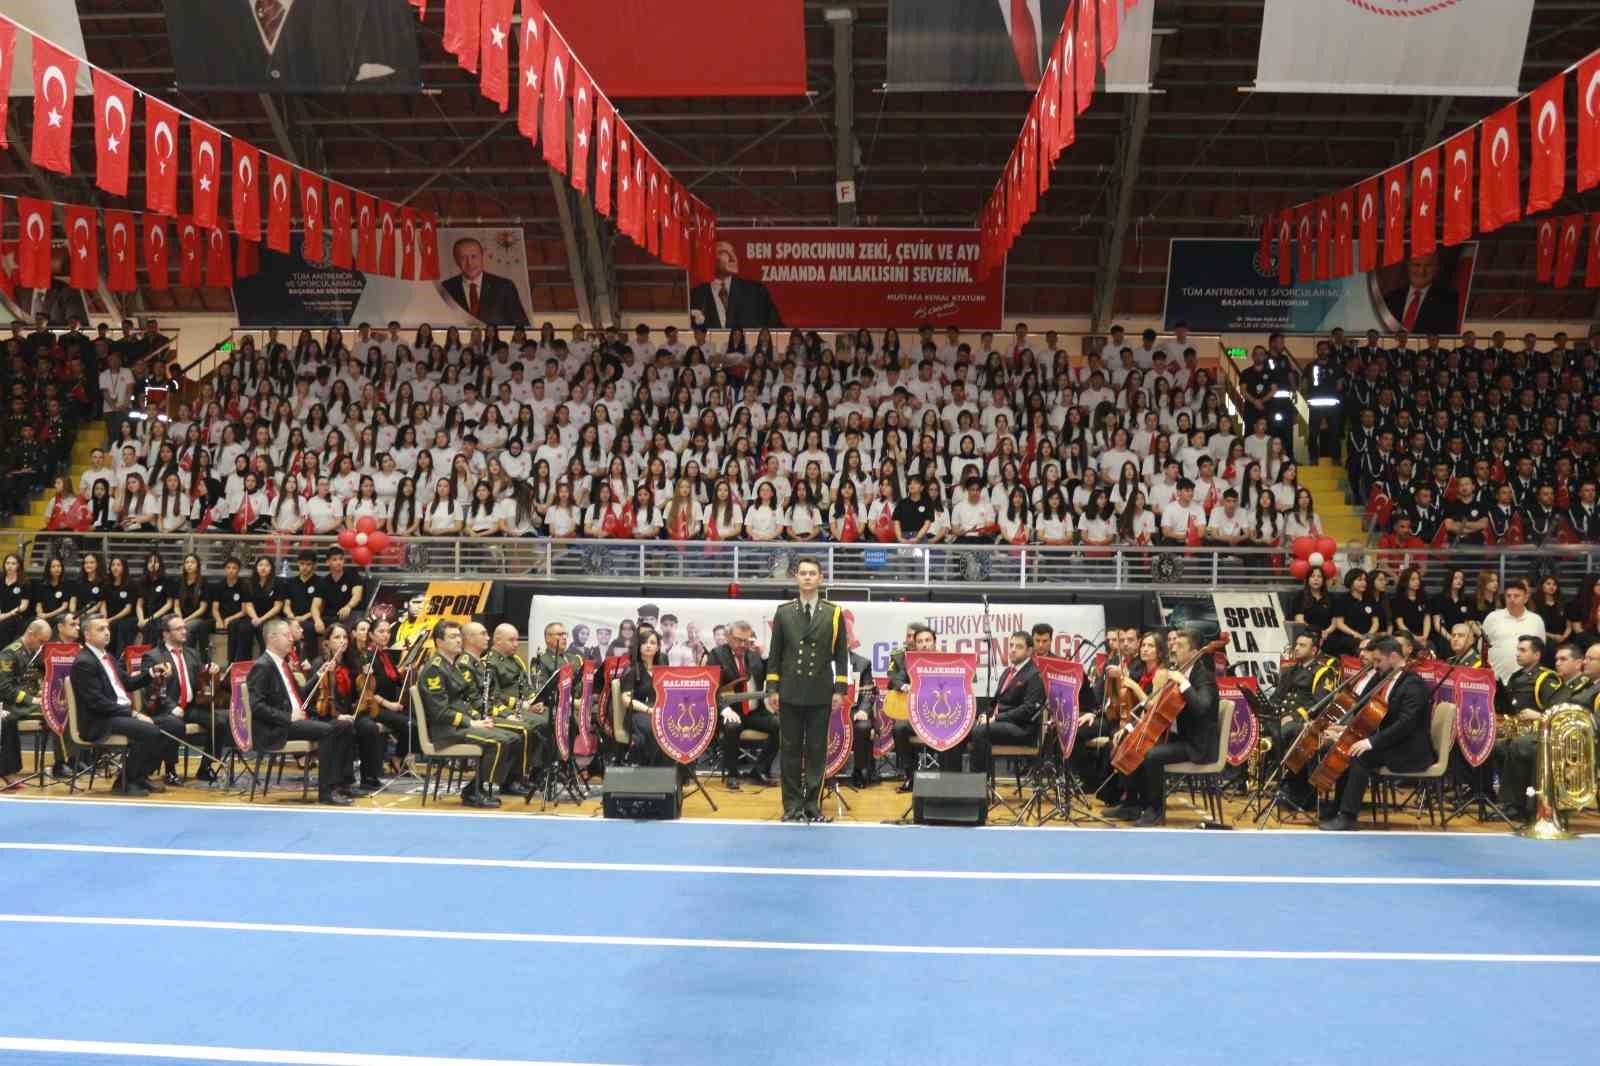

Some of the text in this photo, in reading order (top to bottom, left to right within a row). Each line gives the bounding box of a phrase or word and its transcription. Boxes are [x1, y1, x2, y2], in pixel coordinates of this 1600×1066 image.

[746, 243, 772, 260] BEN
[776, 243, 855, 260] SPORCUNUN
[858, 239, 892, 261] ZEKİ,
[896, 239, 934, 264] ÇEVİK
[937, 244, 953, 260] VE
[761, 262, 974, 283] ZAMANDA AHLAKLISINI SEVERİM.
[426, 594, 481, 616] SPOR
[1223, 607, 1280, 628] SPOR
[1231, 631, 1260, 653] LA
